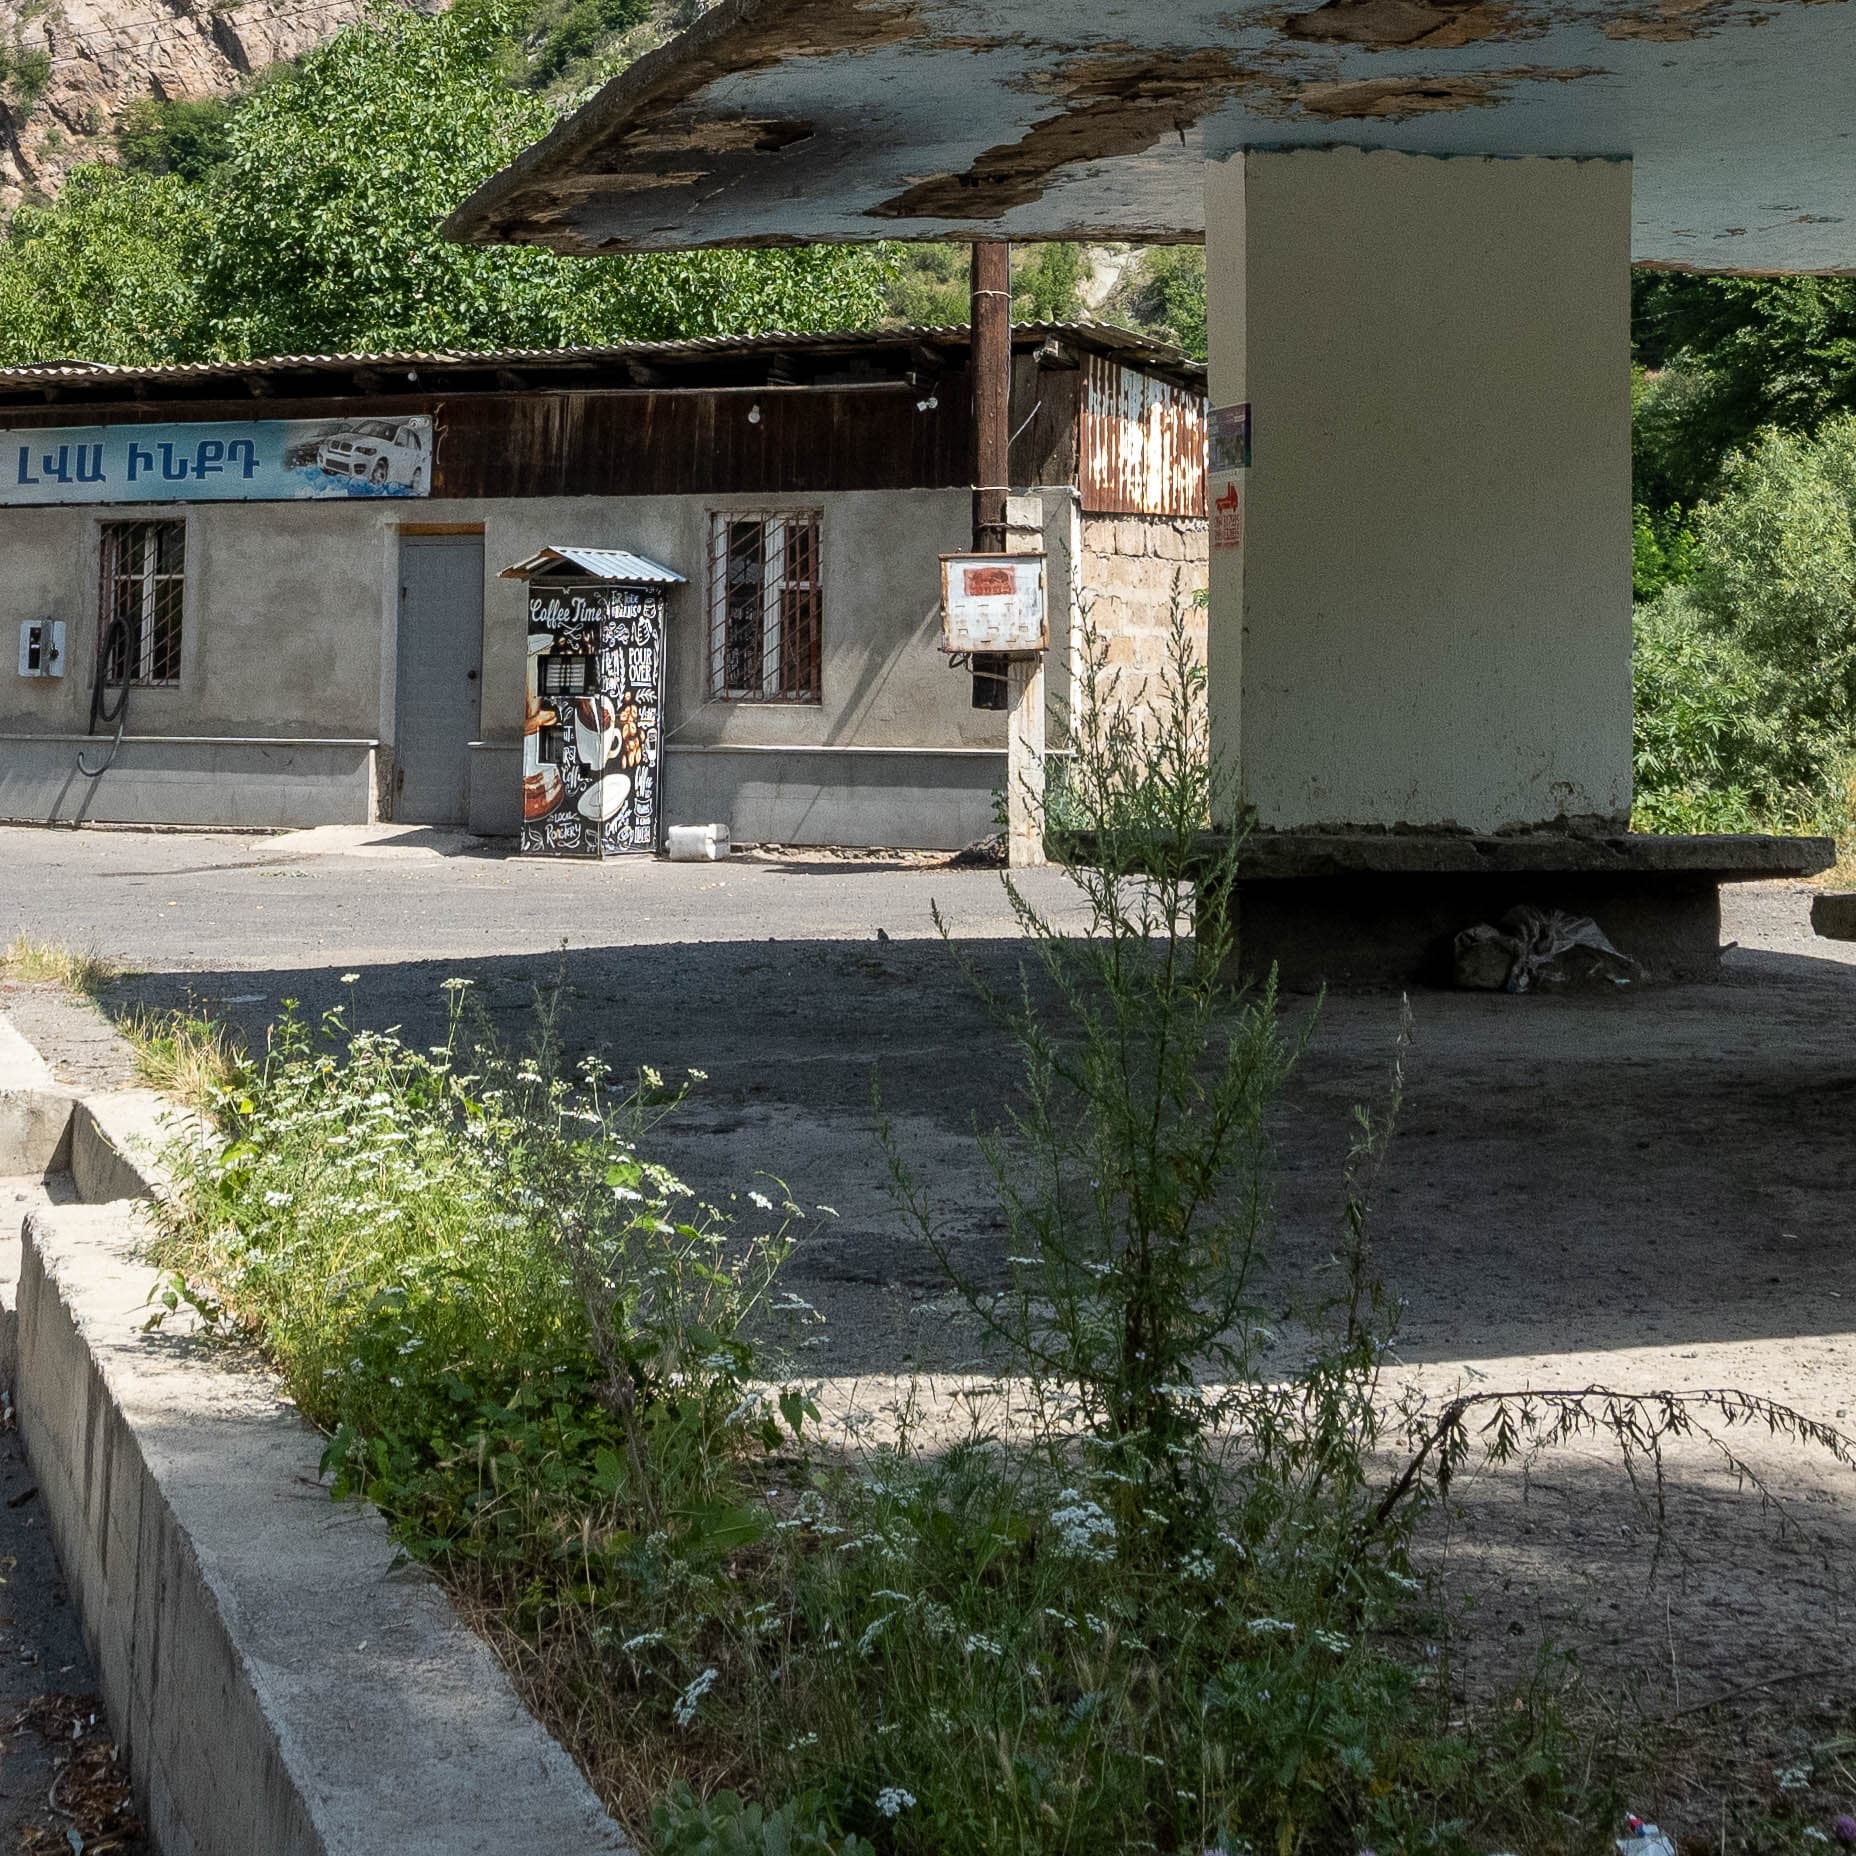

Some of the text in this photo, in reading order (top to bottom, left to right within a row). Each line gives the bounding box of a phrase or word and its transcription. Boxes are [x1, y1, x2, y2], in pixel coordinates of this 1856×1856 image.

[17, 439, 260, 485] ԼՎԱ ԻՆՔԴ
[530, 598, 570, 629] Coffee
[571, 597, 602, 622] Time
[628, 647, 653, 665] POUR
[628, 664, 652, 682] OVER
